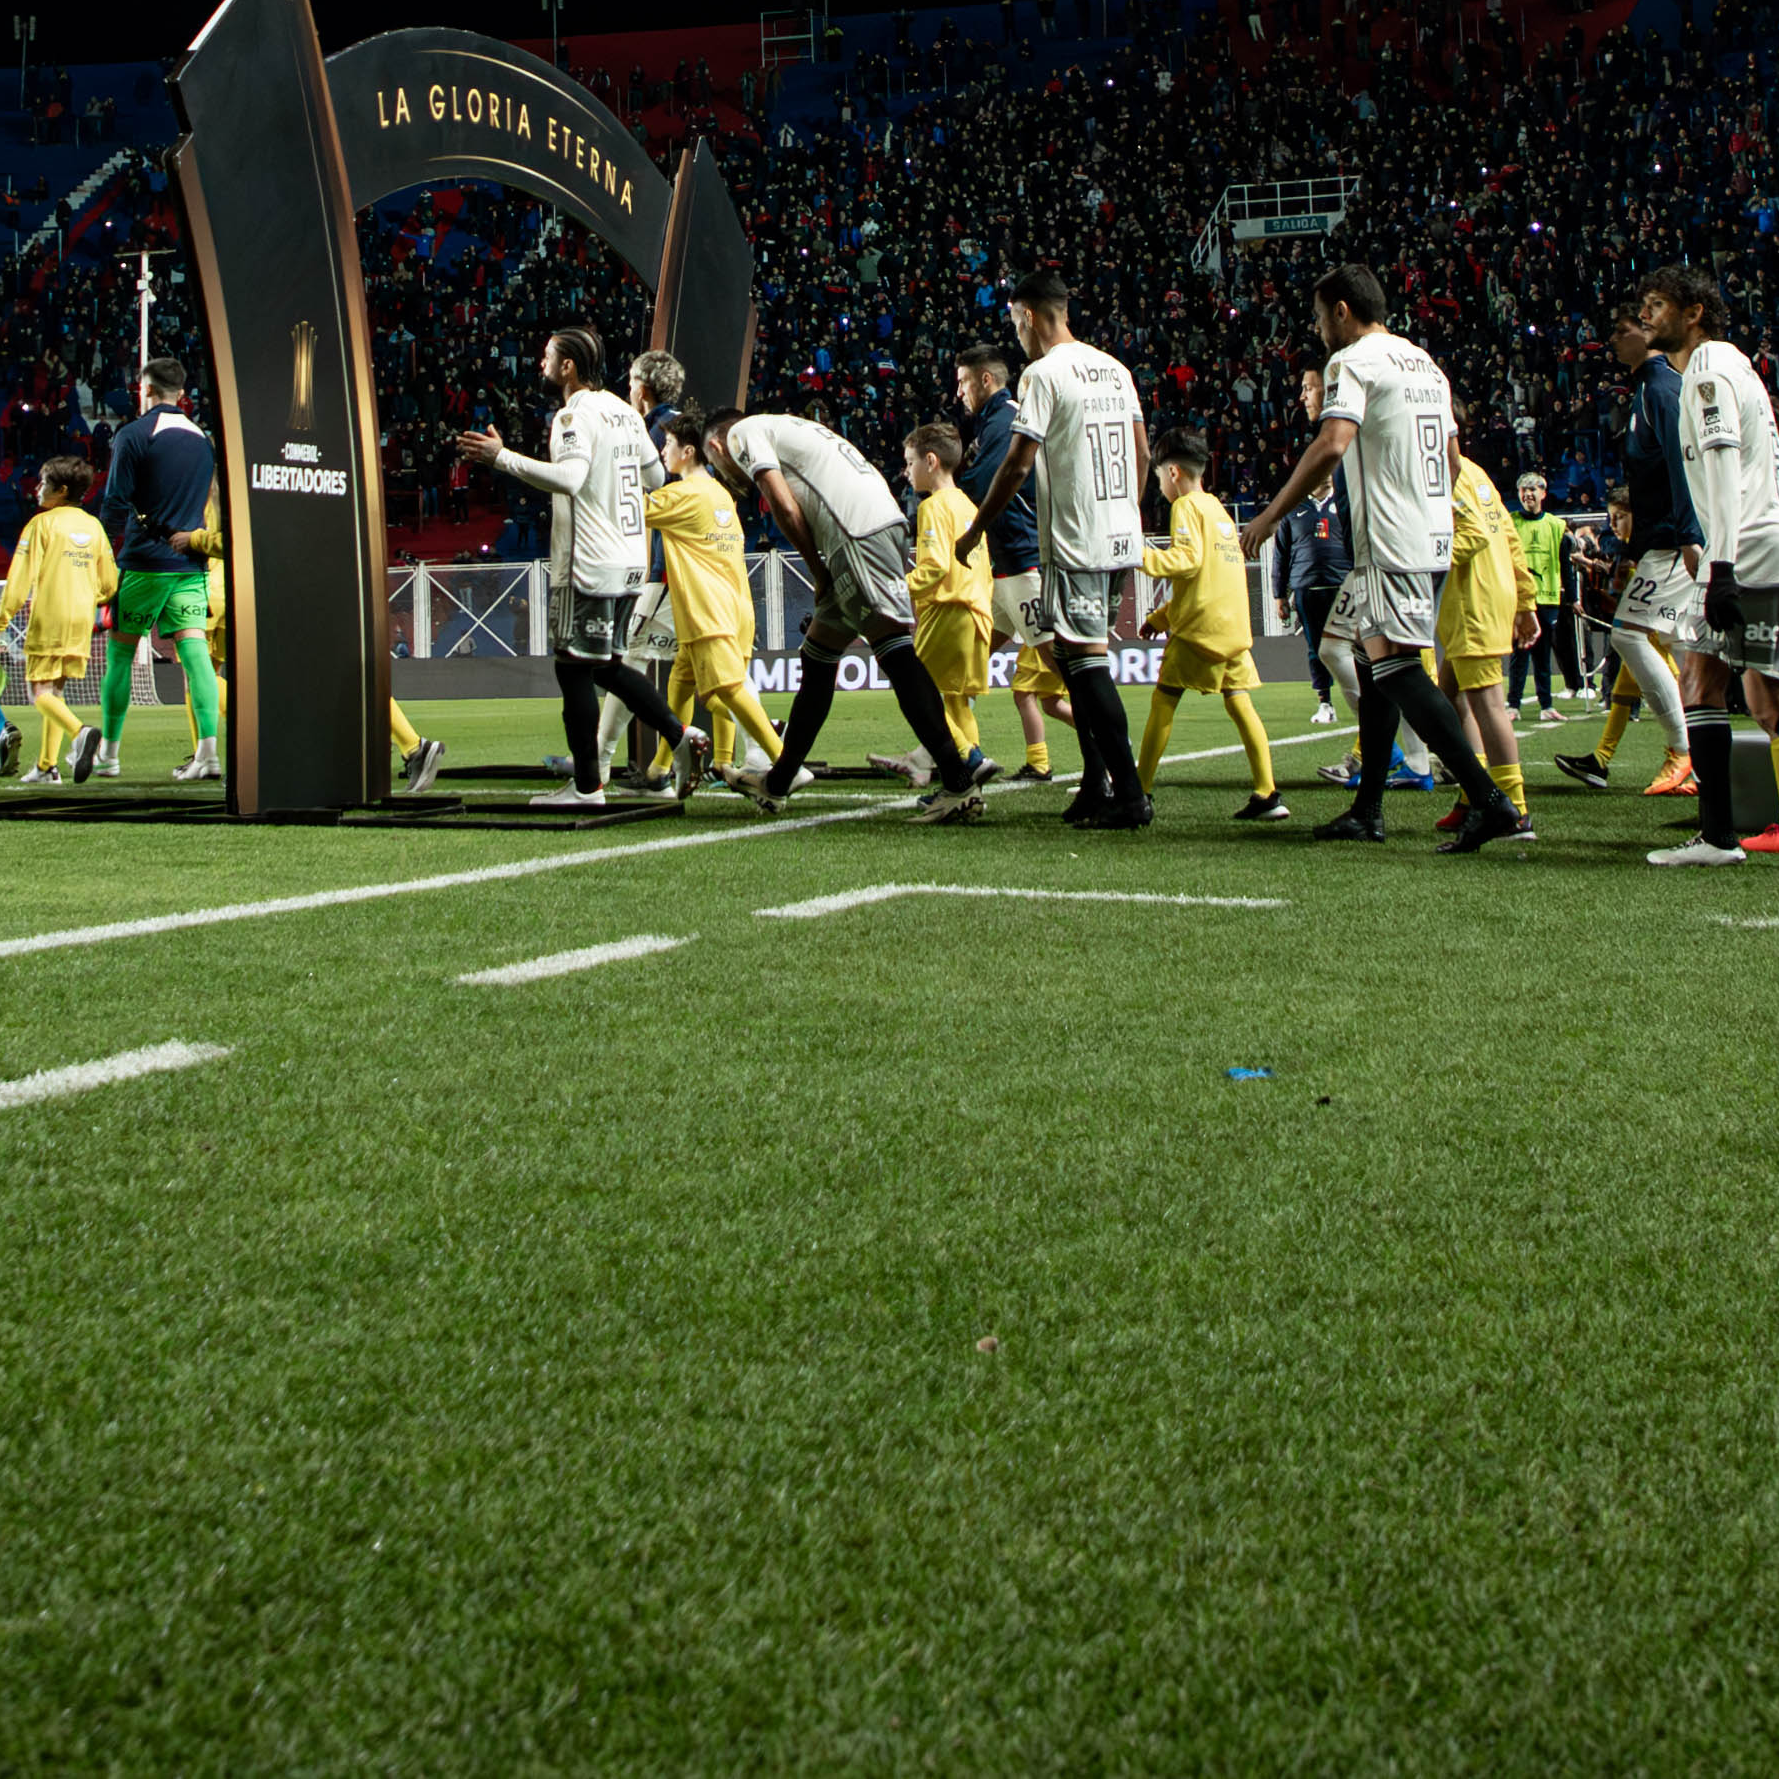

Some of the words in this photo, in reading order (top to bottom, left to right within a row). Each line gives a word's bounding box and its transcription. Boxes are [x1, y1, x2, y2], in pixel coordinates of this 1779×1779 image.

[377, 87, 411, 129] LA
[429, 84, 531, 140] GLORIA
[547, 117, 633, 215] ETERNA
[1272, 218, 1319, 231] SALIDA
[1404, 387, 1443, 404] ALONSO
[1085, 421, 1128, 501] 18
[1416, 414, 1446, 497] 8
[252, 463, 347, 496] LIBERTADORES
[619, 464, 642, 537] 5
[1113, 538, 1129, 557] BH
[1436, 539, 1450, 557] BH
[626, 571, 644, 585] BH
[1628, 576, 1657, 606] 22
